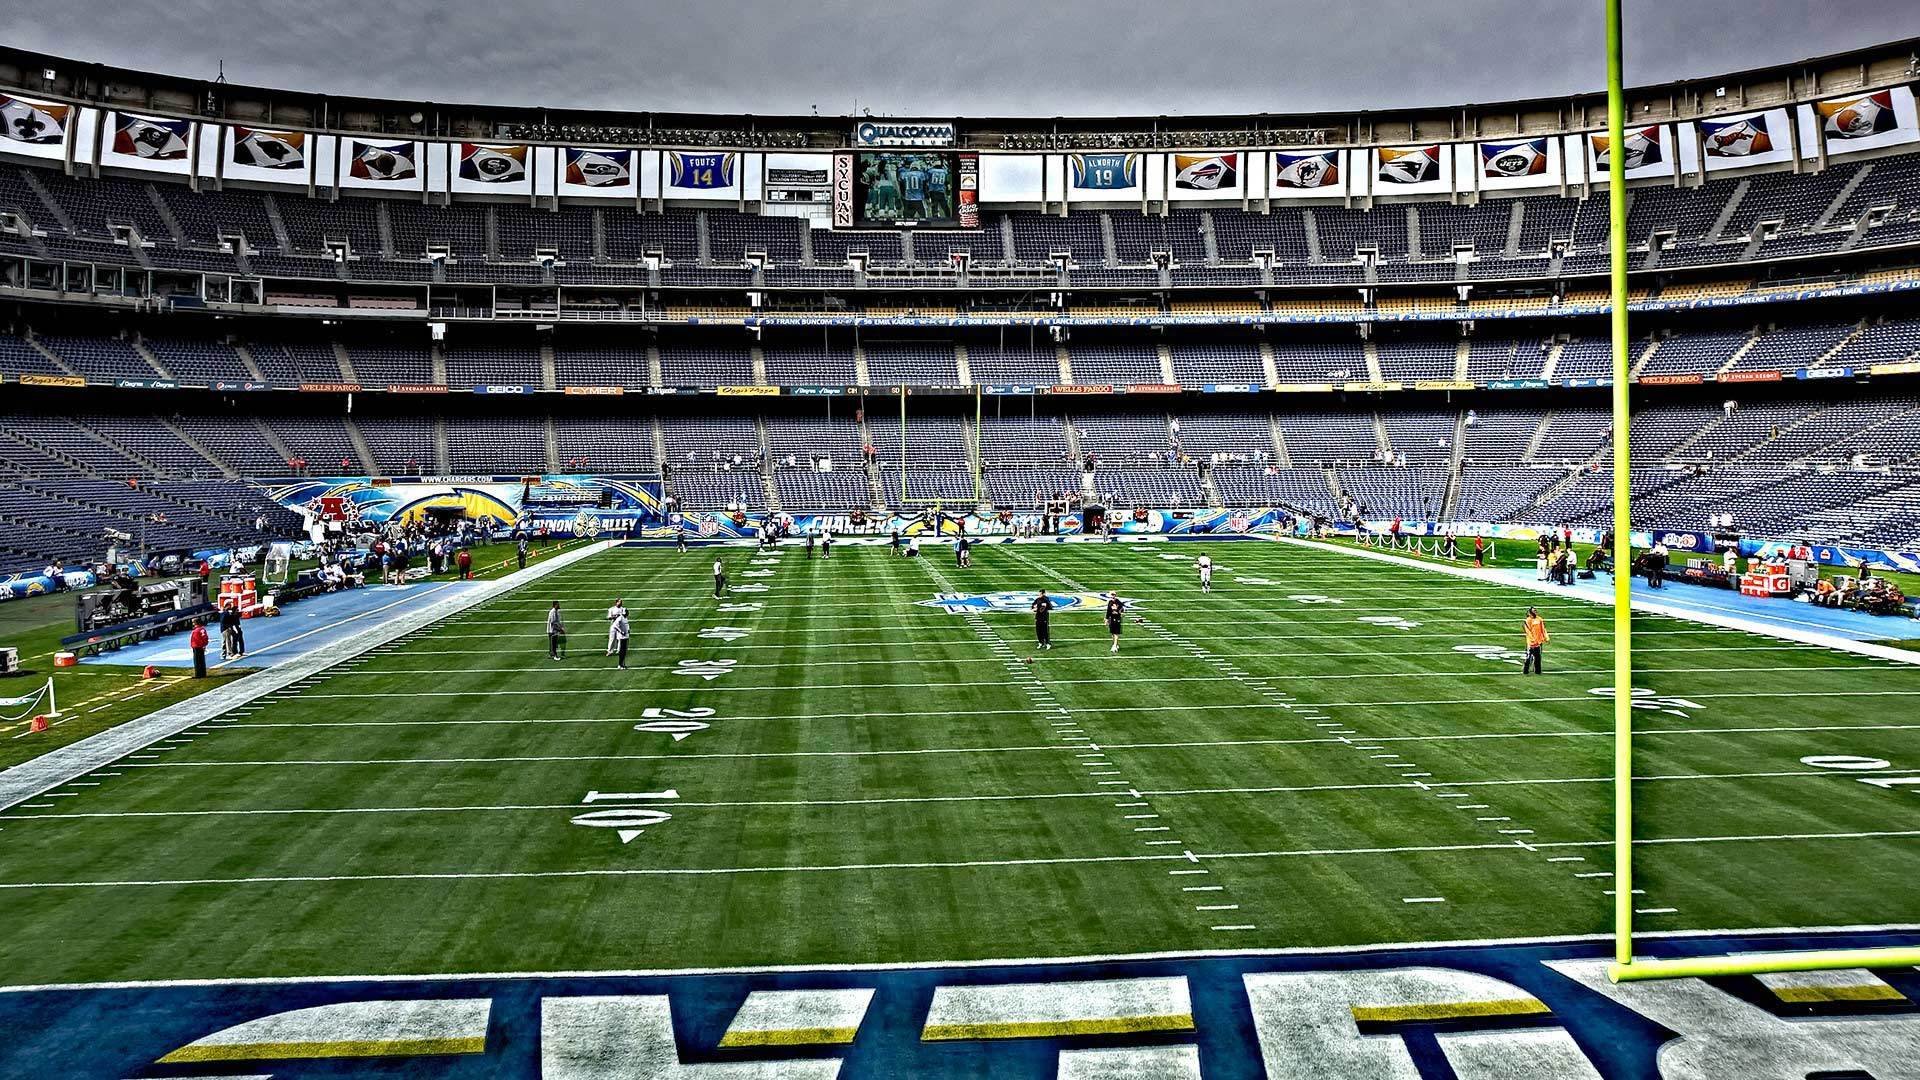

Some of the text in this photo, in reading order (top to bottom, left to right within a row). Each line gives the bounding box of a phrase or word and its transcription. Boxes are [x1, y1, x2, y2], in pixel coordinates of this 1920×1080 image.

[859, 123, 952, 143] QUALCOMM
[690, 158, 716, 167] FOUTS
[1089, 159, 1120, 167] ALWORTH
[693, 169, 713, 185] 14
[905, 175, 919, 190] 10
[932, 172, 946, 184] 68
[1095, 169, 1112, 185] 19
[838, 157, 850, 224] SYCUAN
[1712, 298, 1732, 306] WALT
[1734, 295, 1771, 304] SWEENEY
[1807, 368, 1845, 378] GEICO
[1640, 375, 1699, 384] WELLS FARGO
[602, 518, 638, 531] ALLEY
[701, 523, 717, 533] NFL
[1231, 518, 1247, 528] NFL
[634, 707, 716, 732] 20
[570, 789, 680, 828] 10
